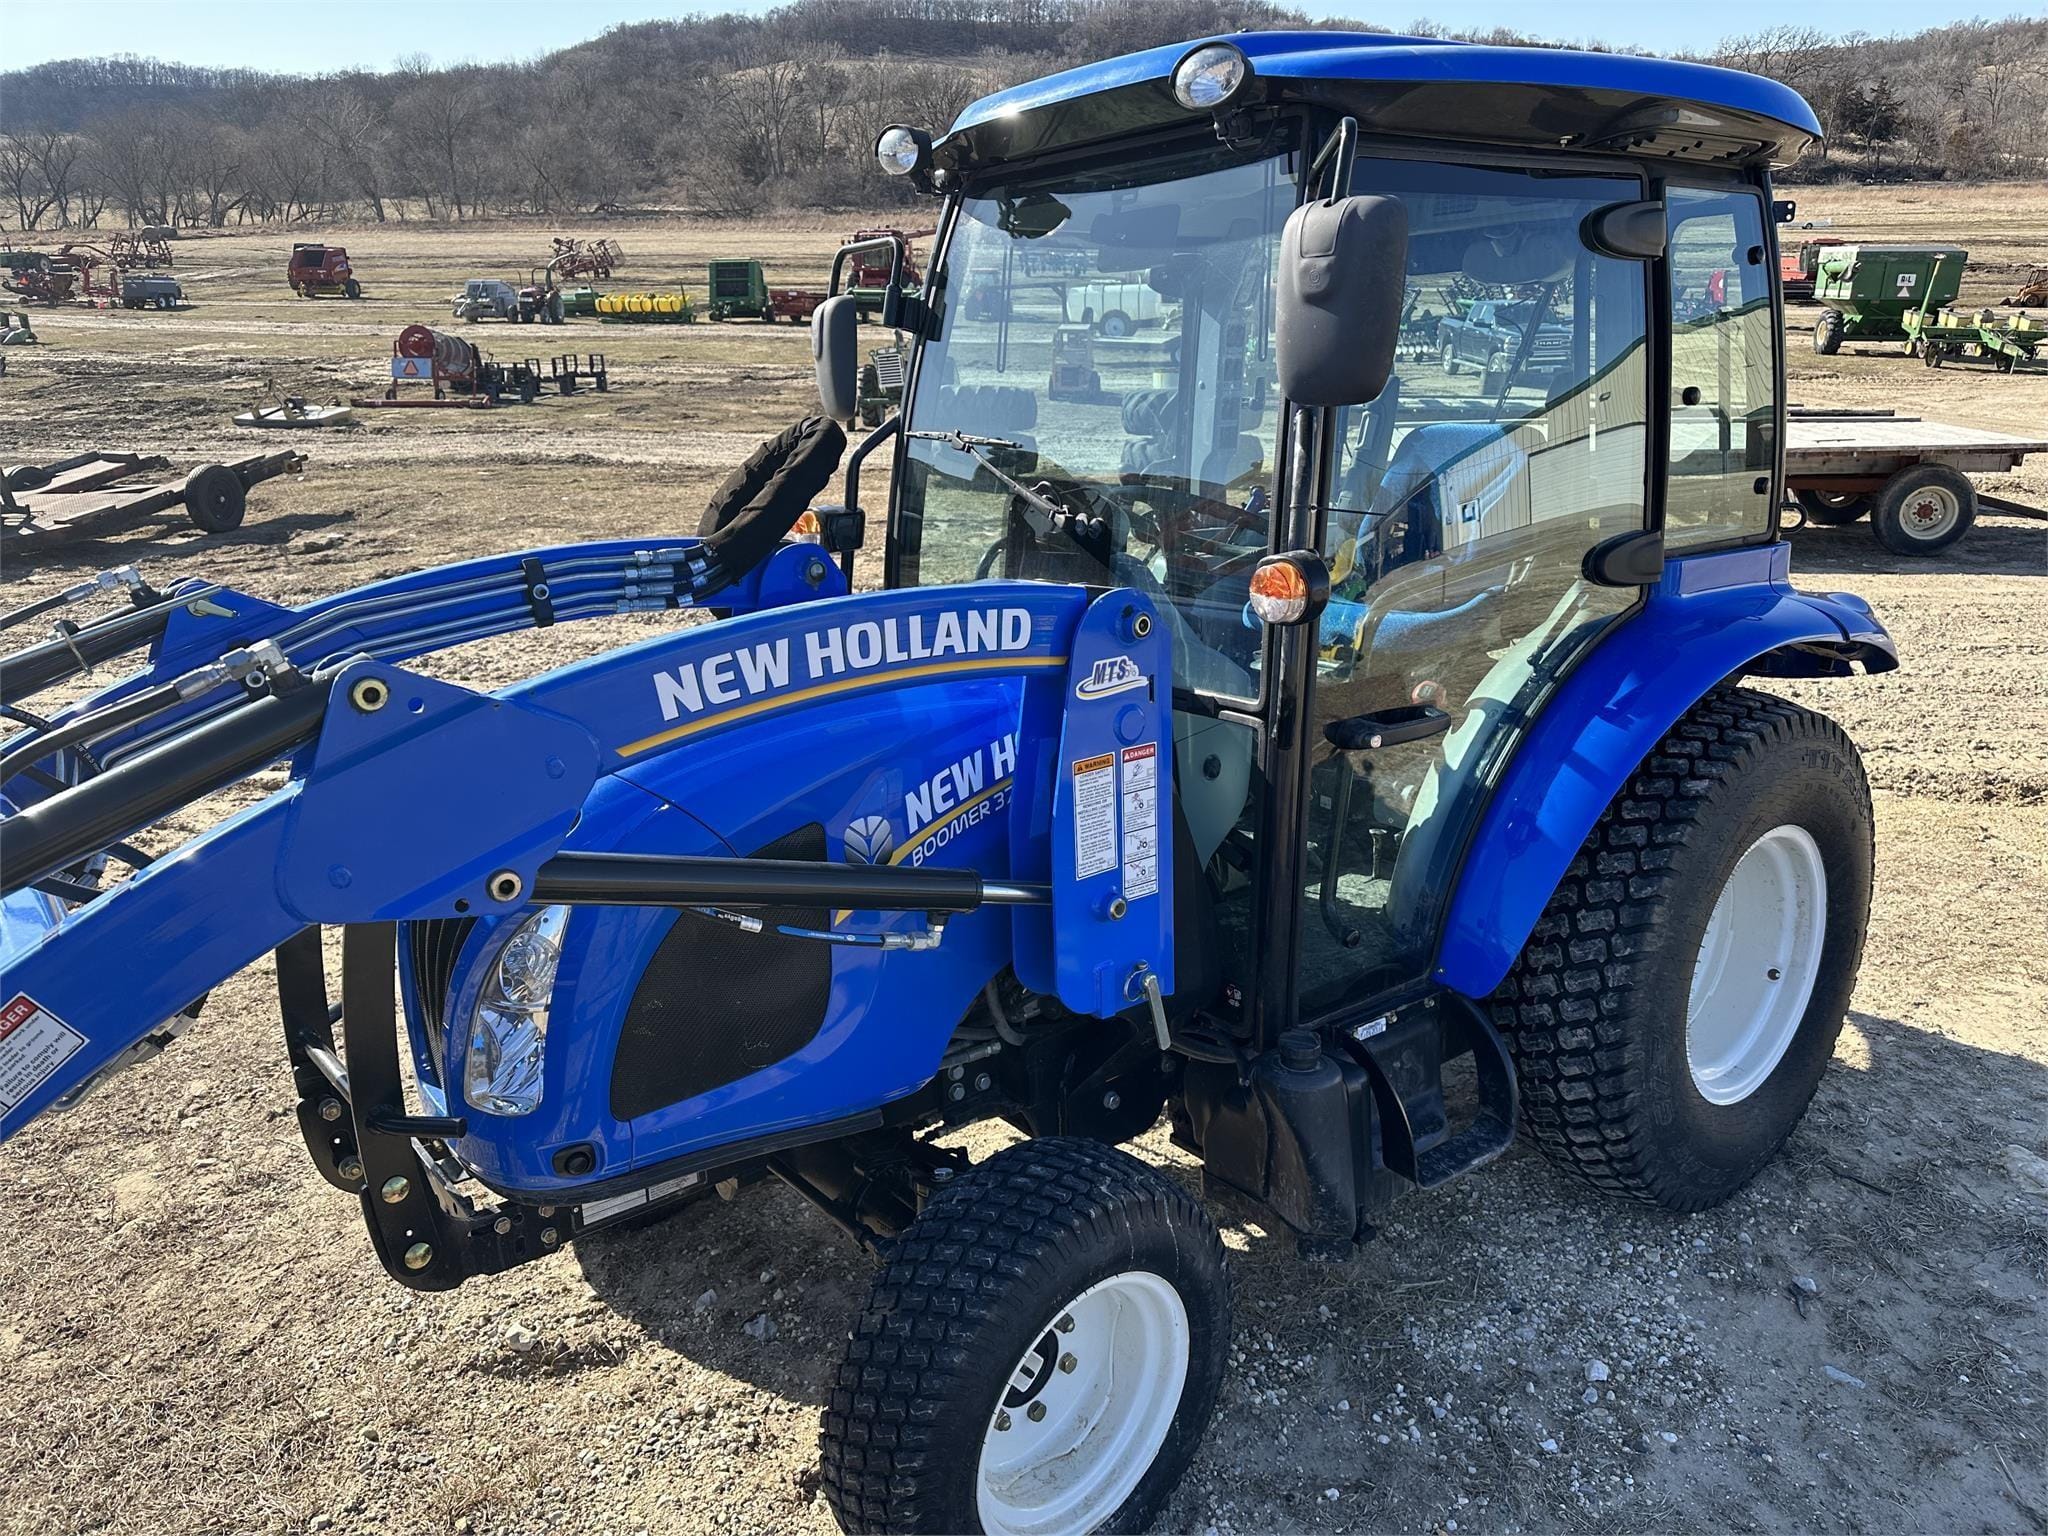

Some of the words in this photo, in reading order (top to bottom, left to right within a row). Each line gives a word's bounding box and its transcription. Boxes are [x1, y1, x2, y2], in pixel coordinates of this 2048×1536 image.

[653, 637, 789, 721] NEW
[805, 608, 1032, 679] HOLLAND
[1093, 658, 1128, 686] MTS
[1084, 758, 1110, 770] WARNING
[1130, 747, 1154, 759] DANGER
[905, 749, 983, 834] NEW
[990, 733, 1019, 780] H
[912, 800, 991, 867] BOOMER
[0, 1004, 29, 1035] GER
[21, 1063, 31, 1072] to
[30, 1042, 54, 1065] comply
[53, 1031, 67, 1043] will
[6, 1076, 26, 1096] result
[24, 1071, 33, 1079] in
[32, 1055, 52, 1072] death
[50, 1047, 59, 1055] or
[12, 1078, 36, 1099] serious
